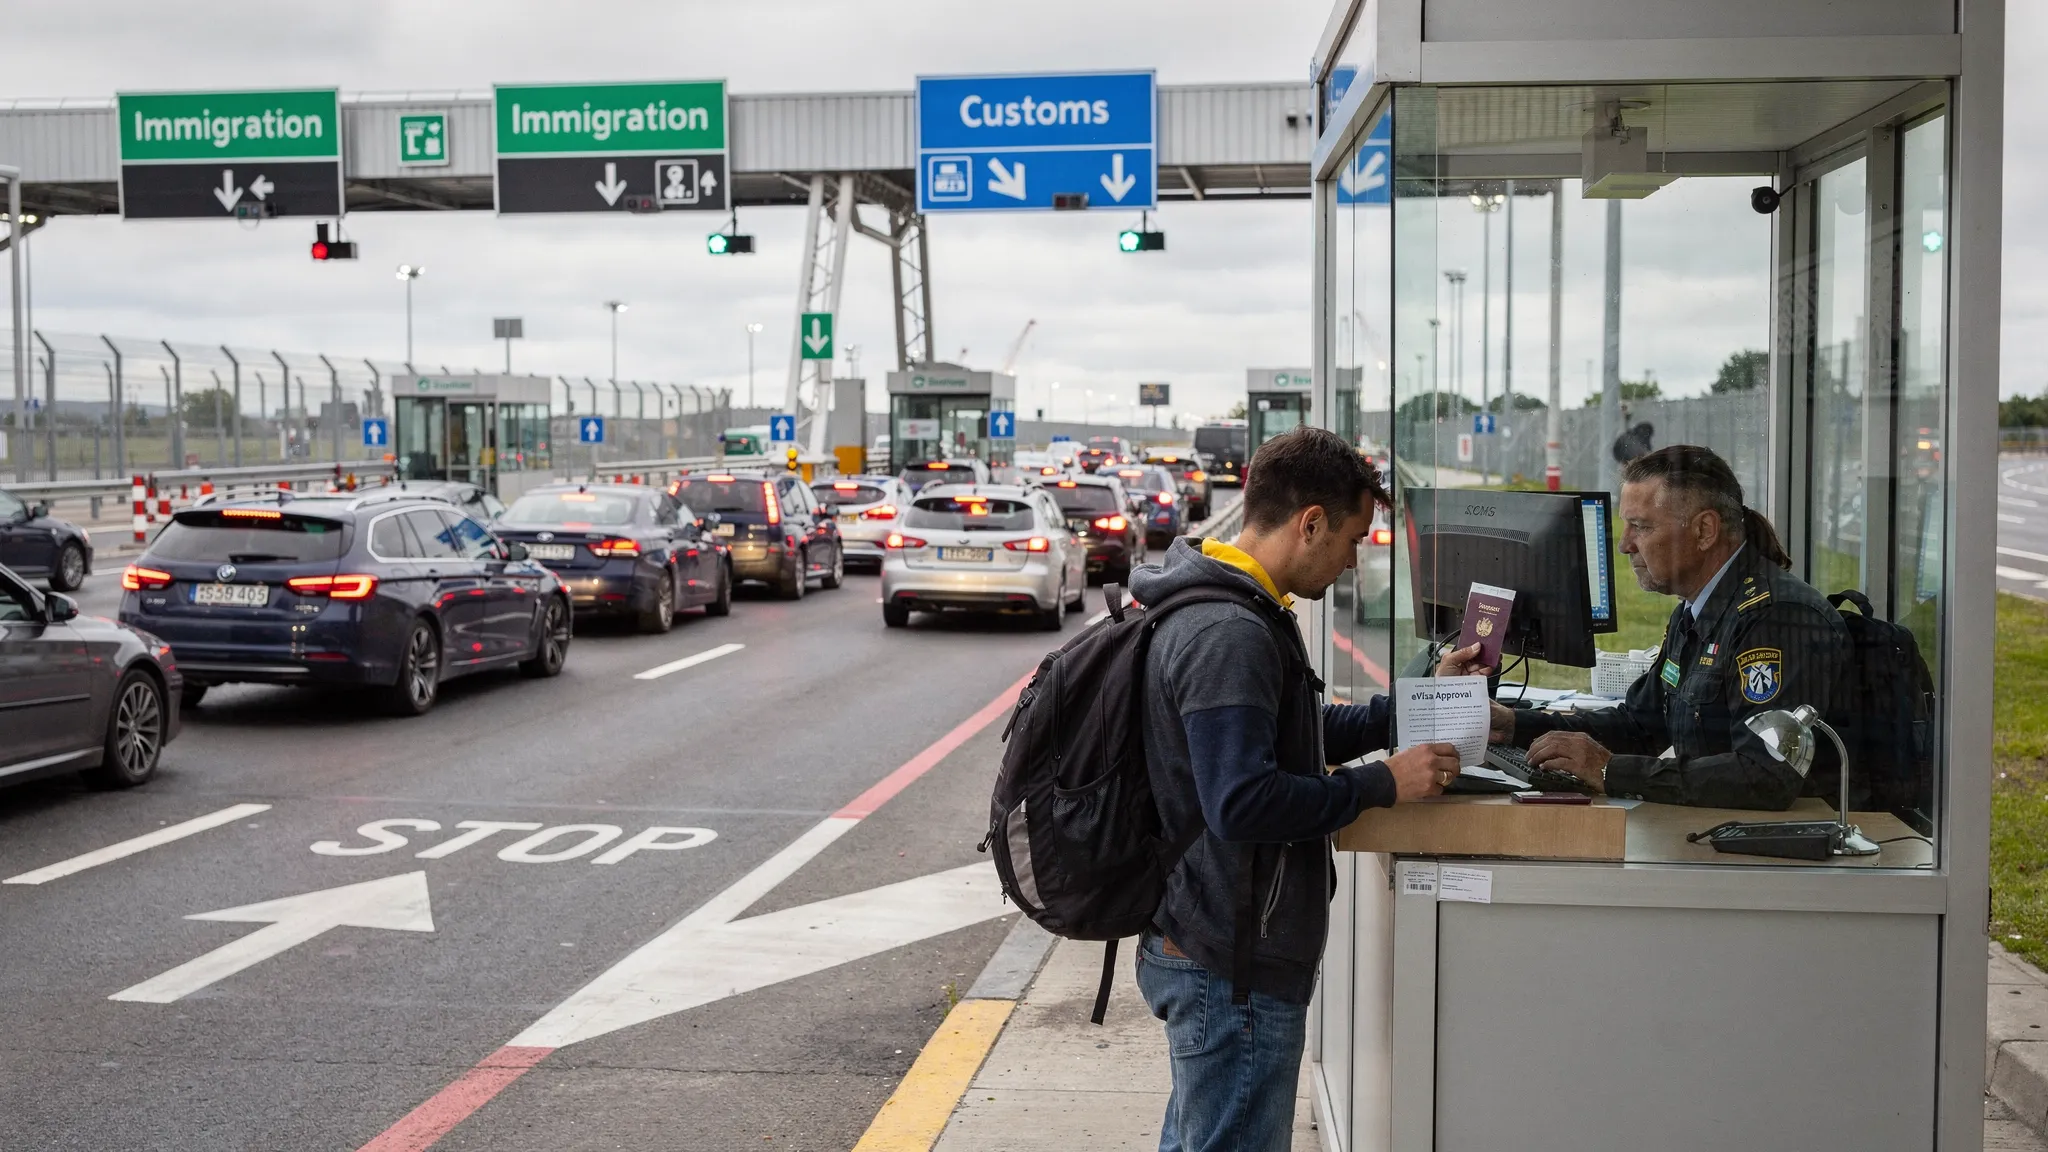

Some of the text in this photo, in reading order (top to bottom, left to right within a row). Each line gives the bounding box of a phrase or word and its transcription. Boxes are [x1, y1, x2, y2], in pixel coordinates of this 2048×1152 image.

[135, 109, 322, 147] Immigration
[513, 101, 709, 141] Immigration
[960, 95, 1109, 128] Customs
[1411, 690, 1473, 702] eVisa Approval
[309, 818, 718, 866] STOP
